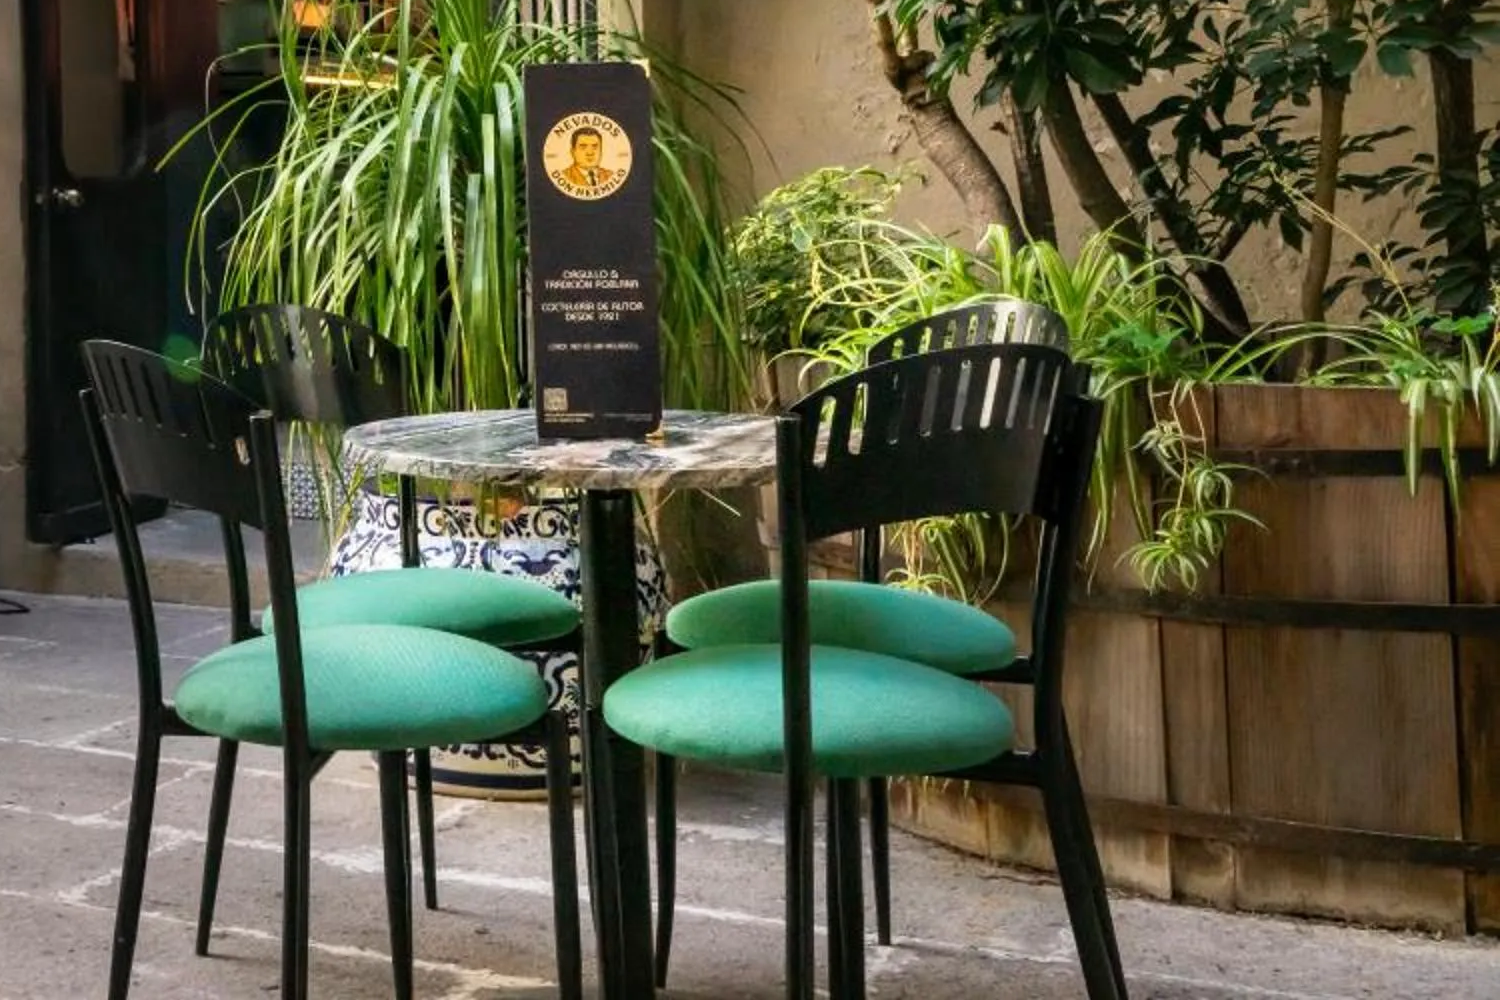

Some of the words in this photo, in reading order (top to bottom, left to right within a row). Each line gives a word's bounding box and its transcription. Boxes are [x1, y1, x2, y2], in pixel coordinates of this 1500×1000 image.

[554, 115, 620, 138] NEVADOS
[551, 170, 574, 193] DON
[576, 168, 627, 197] HERMILO
[597, 302, 609, 311] DE
[611, 301, 644, 311] AUTOR
